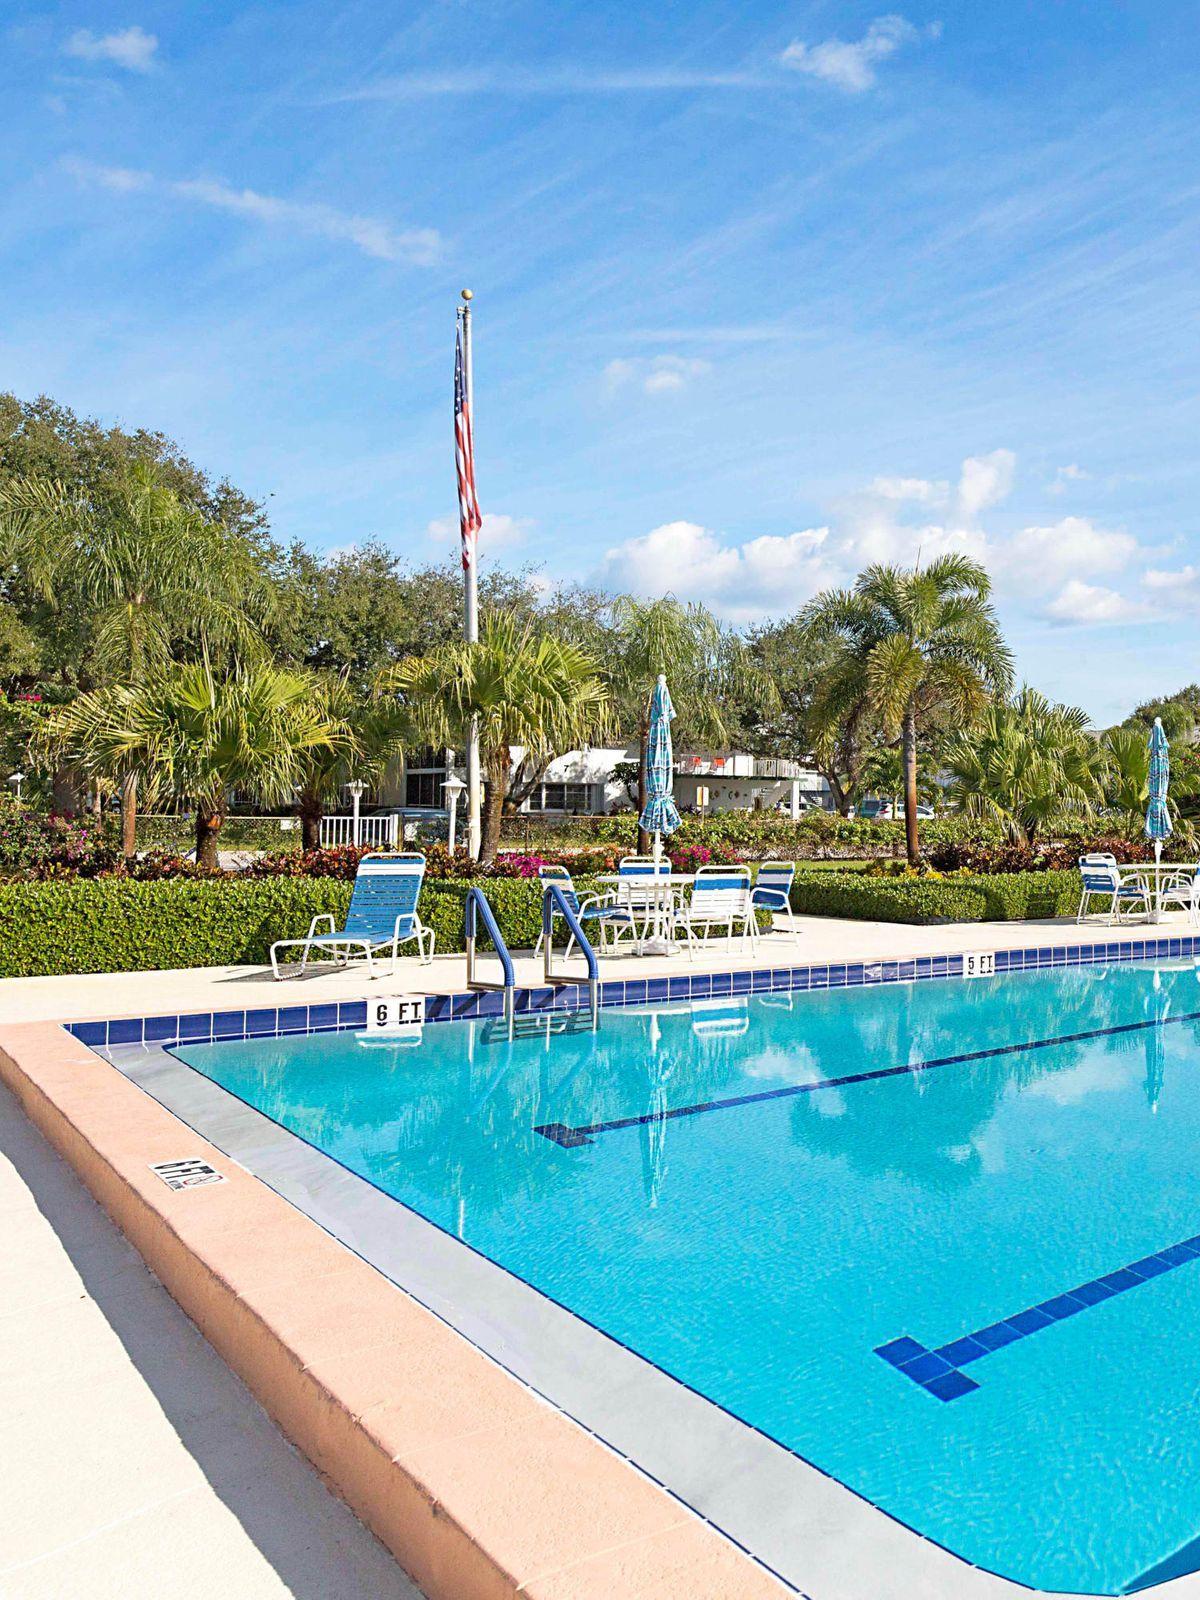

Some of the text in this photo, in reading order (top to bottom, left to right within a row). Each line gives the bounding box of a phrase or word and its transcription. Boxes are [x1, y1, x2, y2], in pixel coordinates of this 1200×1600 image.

[968, 955, 993, 975] 5 FT
[376, 1004, 388, 1027] 6
[154, 1160, 216, 1180] 6 FT
